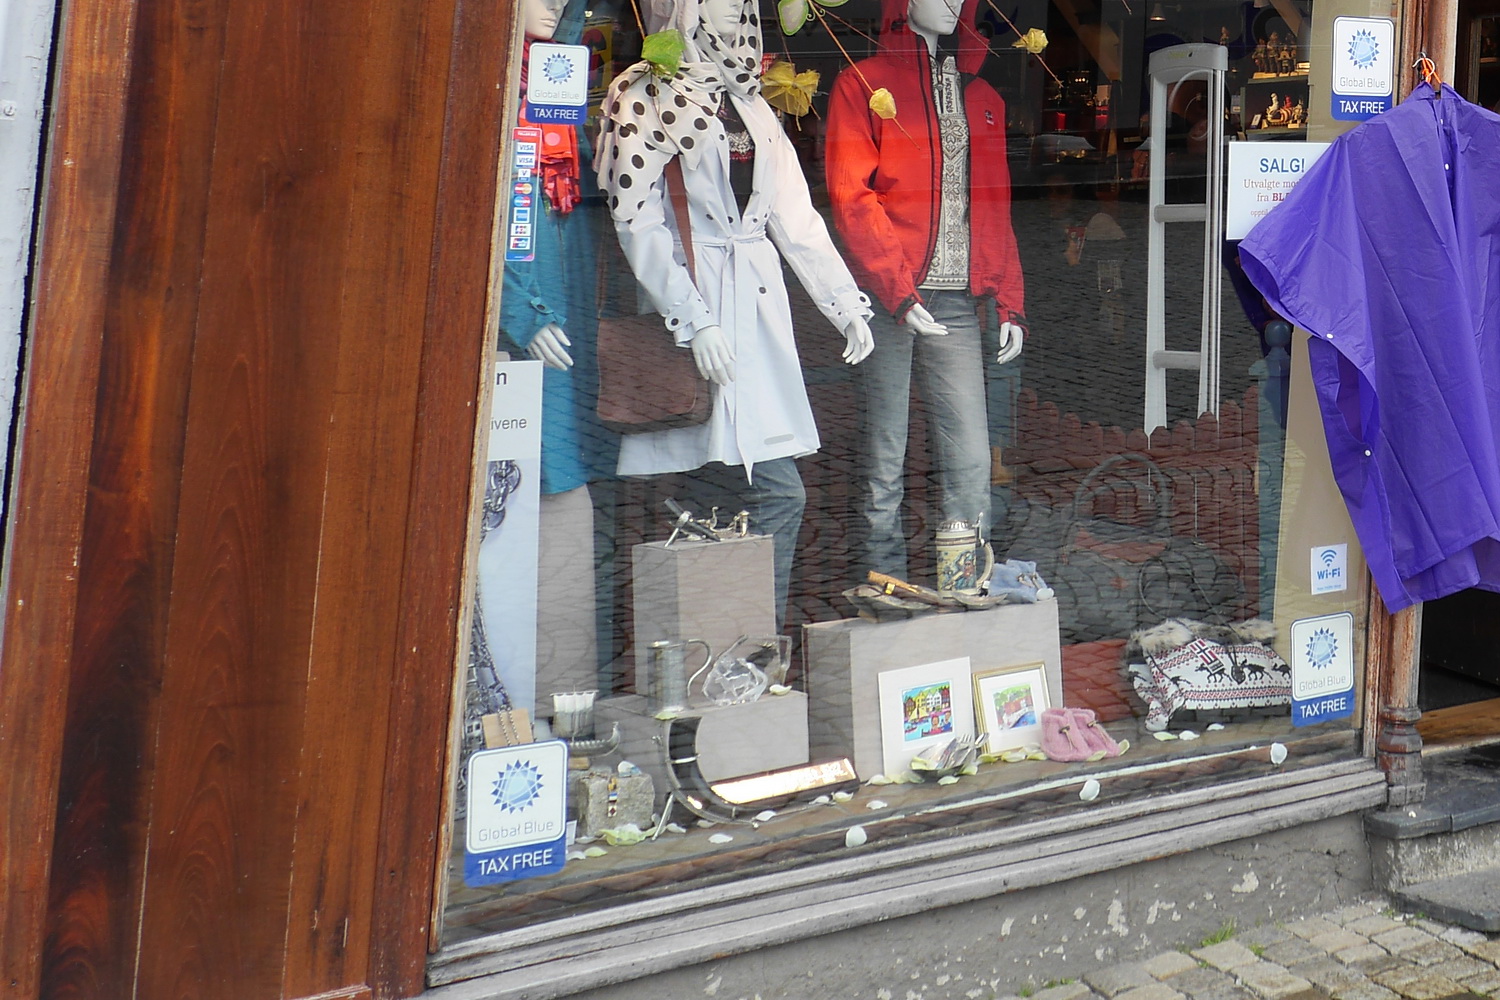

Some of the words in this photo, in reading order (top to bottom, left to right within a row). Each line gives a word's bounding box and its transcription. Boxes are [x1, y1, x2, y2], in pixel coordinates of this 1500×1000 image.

[1340, 76, 1366, 88] Global
[1367, 77, 1386, 89] Blue
[534, 89, 560, 99] Global
[561, 90, 580, 100] Blue
[534, 107, 553, 119] TAX
[554, 108, 579, 120] FREE
[1339, 100, 1359, 114] TAX
[1360, 101, 1385, 114] FREE
[1260, 158, 1305, 173] SALG!
[1243, 179, 1280, 190] Utvalgte
[1257, 192, 1269, 202] fra
[490, 417, 527, 430] ivene
[1316, 567, 1341, 580] Wi-Fi
[1299, 678, 1326, 692] Global
[1327, 675, 1347, 686] Blue
[1300, 704, 1321, 719] TAX
[1320, 697, 1347, 715] FREE
[478, 824, 521, 842] Global
[524, 820, 554, 835] Blue
[478, 856, 509, 876] TAX
[512, 848, 553, 870] FREE
